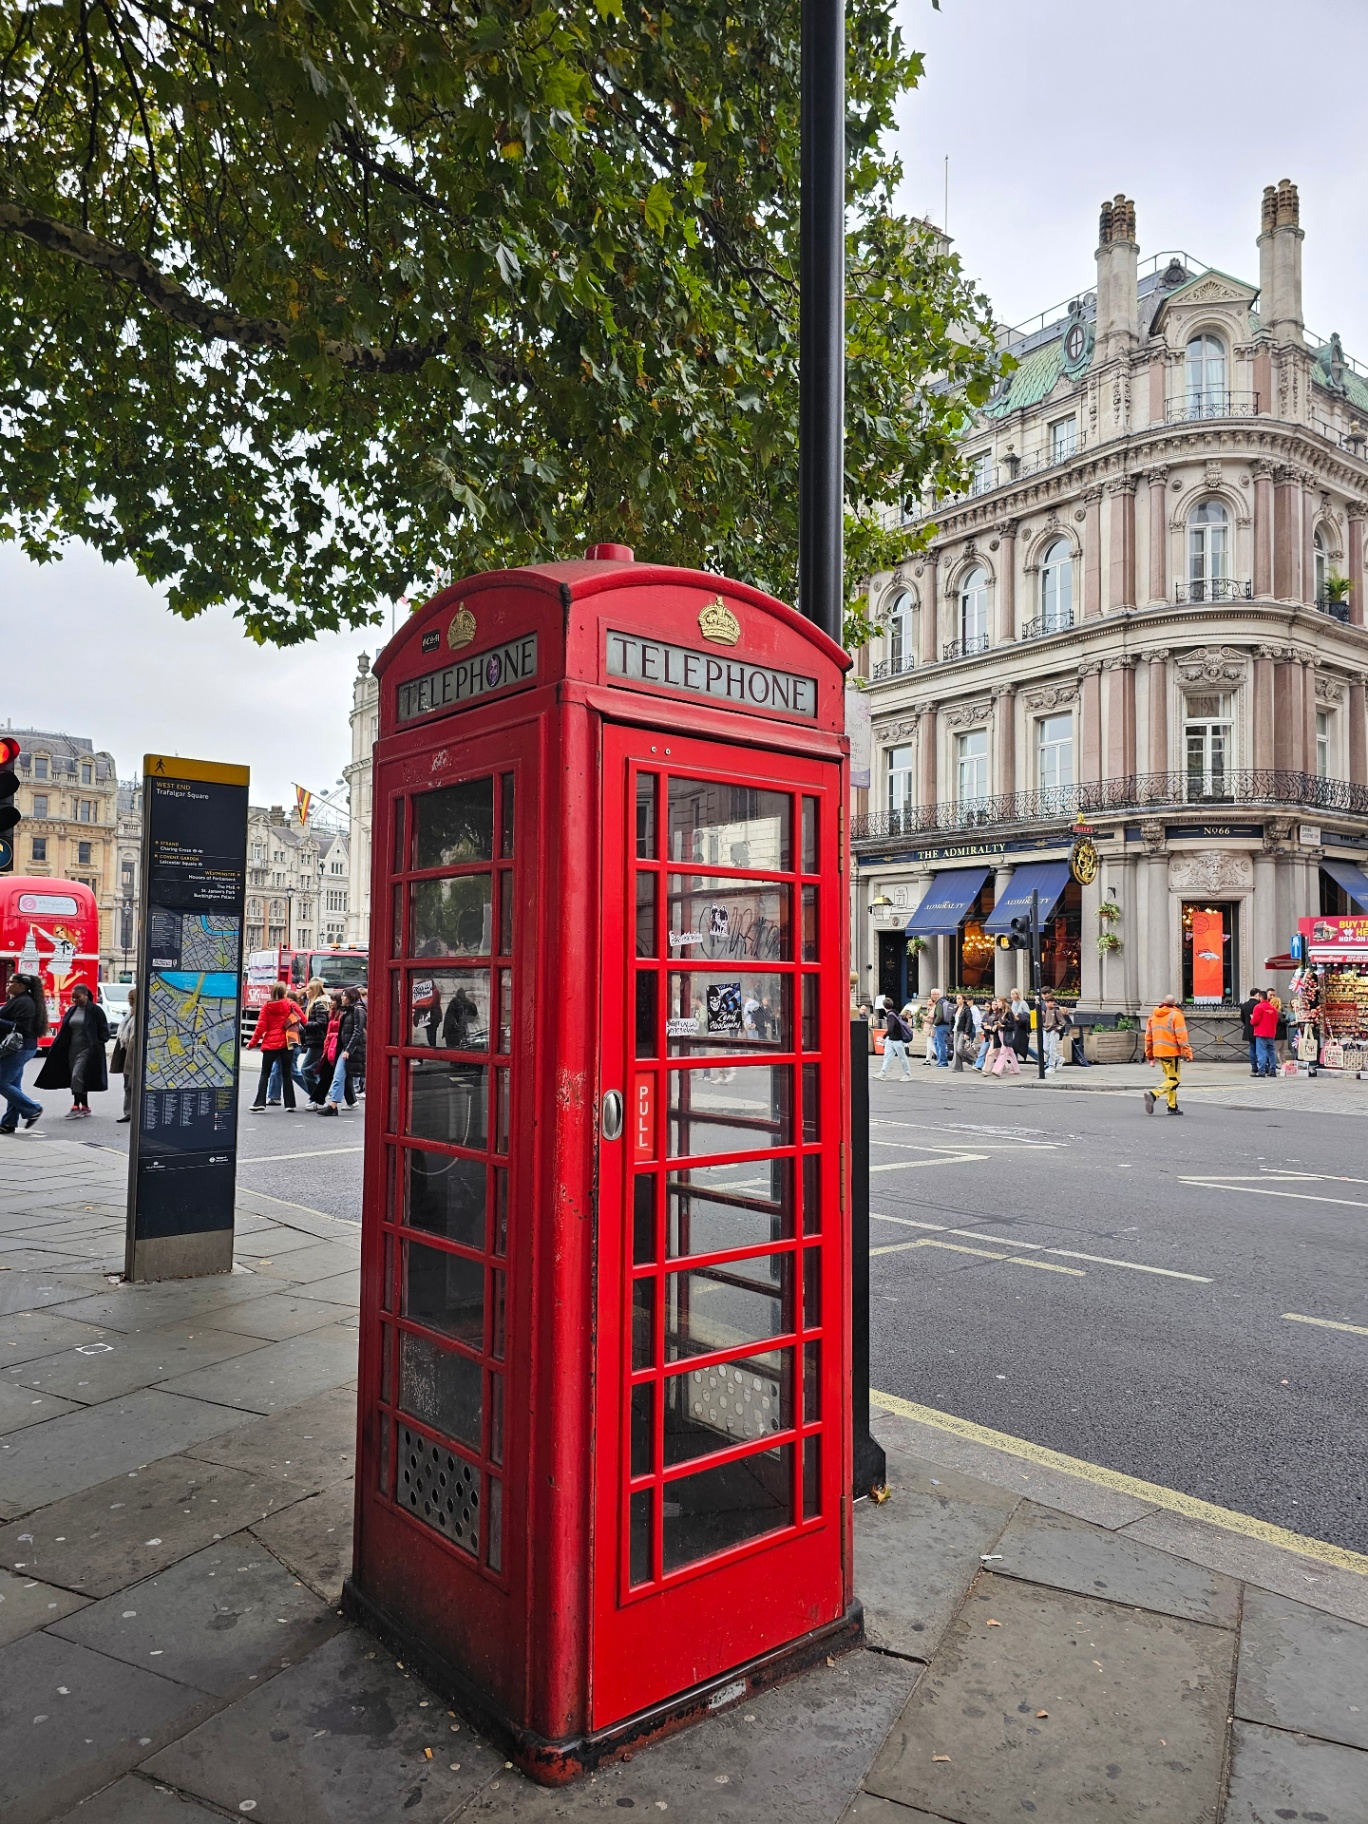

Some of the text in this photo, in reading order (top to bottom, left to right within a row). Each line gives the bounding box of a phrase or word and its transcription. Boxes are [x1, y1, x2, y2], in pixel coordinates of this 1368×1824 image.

[402, 639, 536, 716] TELEPHONE
[612, 637, 808, 711] TELEPHONE
[156, 788, 209, 799] Trafalgar Square
[917, 843, 1006, 860] THE ADMIRALTY
[1003, 898, 1052, 906] ADMIRTY
[1339, 921, 1358, 929] BUY
[638, 1086, 649, 1147] PULL
